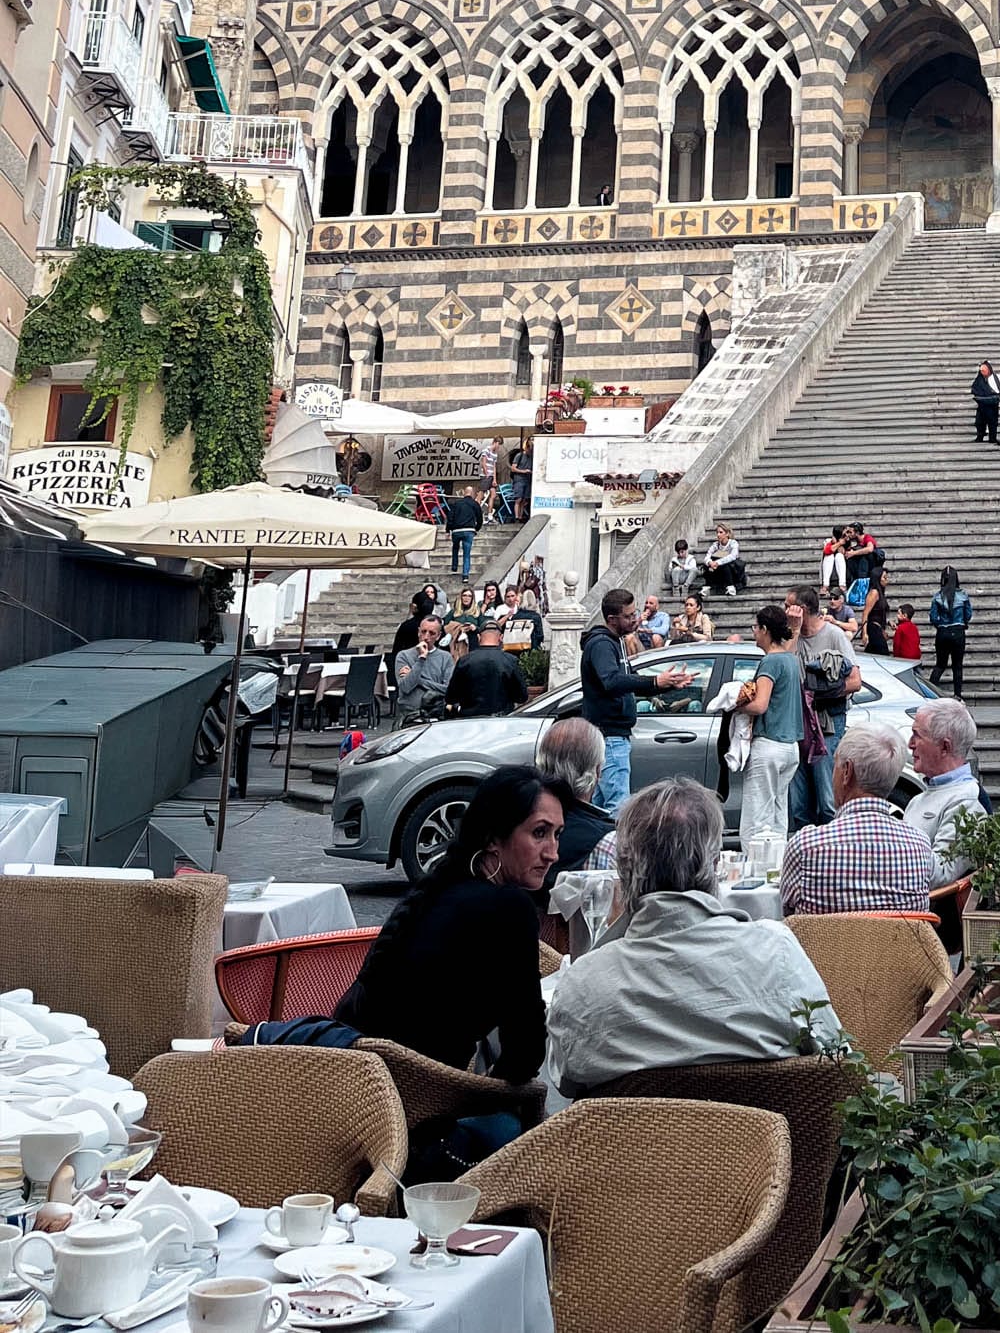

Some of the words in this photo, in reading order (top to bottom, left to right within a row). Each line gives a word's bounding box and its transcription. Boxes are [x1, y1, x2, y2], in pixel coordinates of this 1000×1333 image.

[298, 384, 340, 406] RISTORANTE
[297, 405, 341, 414] HIOSTRO
[57, 449, 75, 458] dal
[80, 449, 107, 459] 1934
[394, 438, 432, 460] TAVERNA
[12, 459, 146, 482] RISTORANTE
[391, 462, 480, 478] RISTORANTE
[27, 475, 126, 493] PIZZERIA
[604, 482, 642, 491] PANINI
[645, 482, 652, 490] E
[47, 491, 132, 509] ANDREA
[170, 529, 246, 544] RANTE
[256, 530, 348, 546] PIZZERIA
[358, 532, 397, 547] BAR
